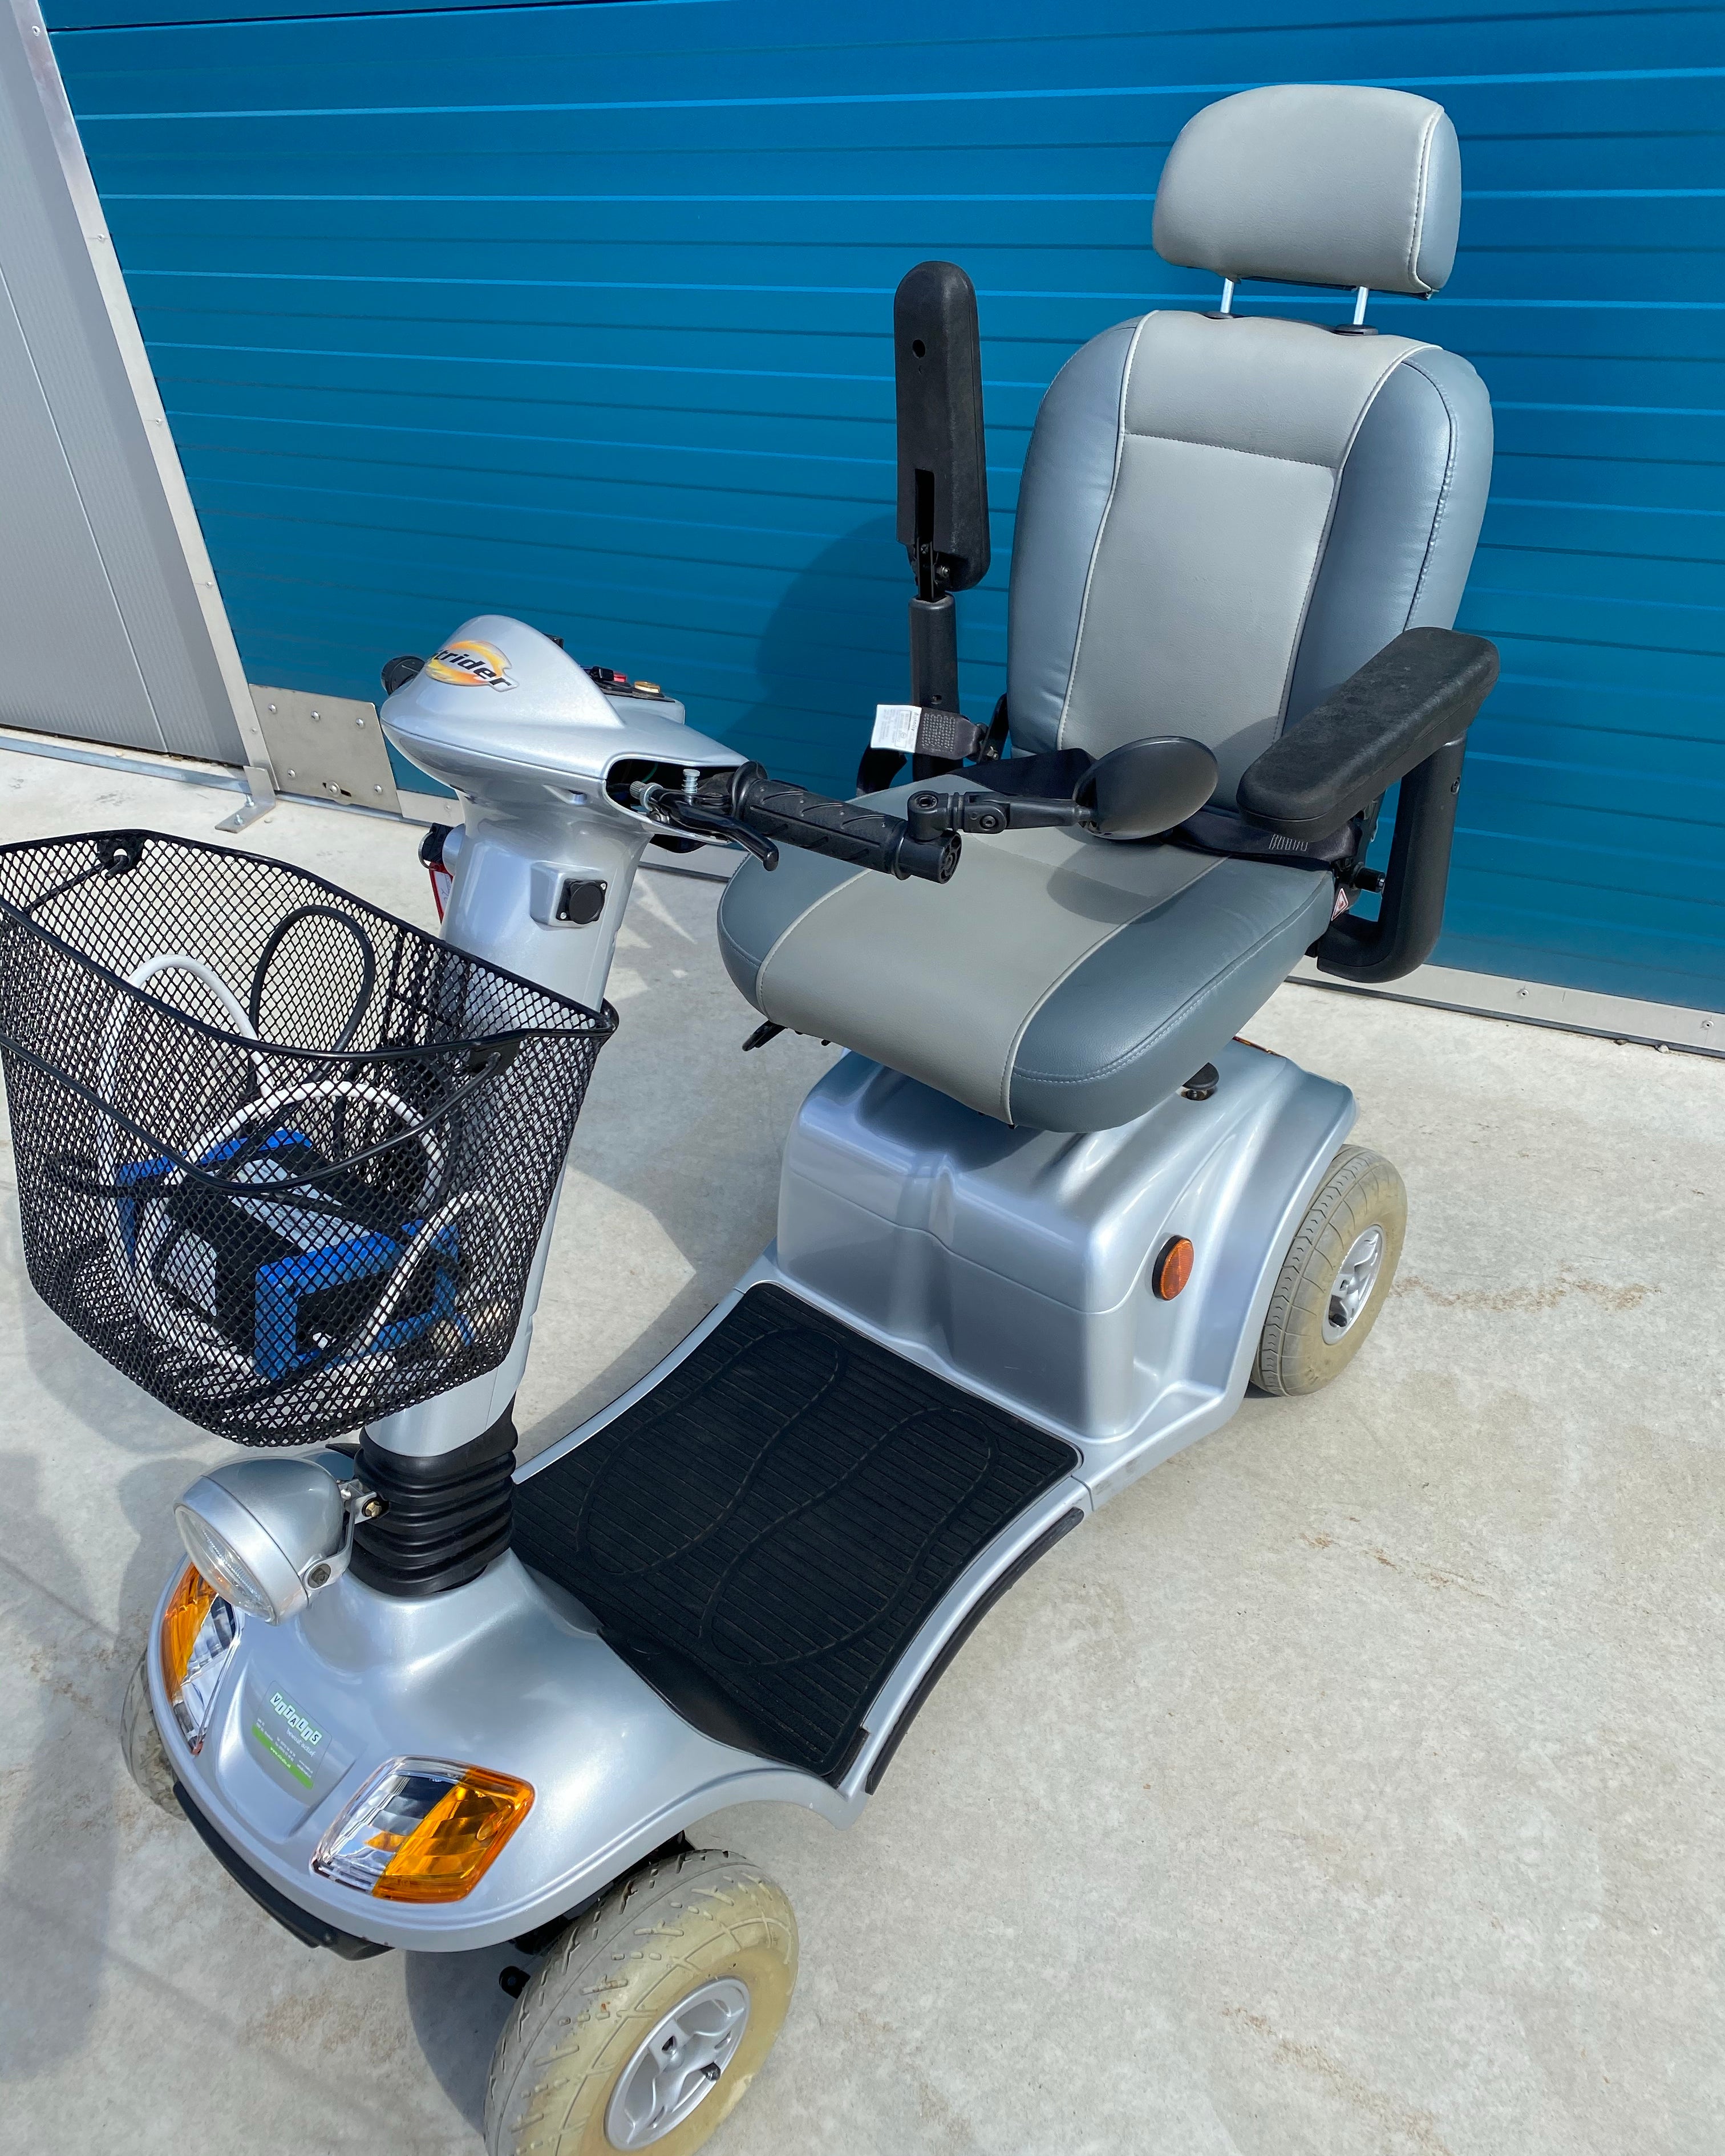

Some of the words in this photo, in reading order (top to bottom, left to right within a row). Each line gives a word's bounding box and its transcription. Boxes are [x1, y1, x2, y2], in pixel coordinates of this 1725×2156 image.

[430, 649, 512, 686] trider
[911, 711, 920, 732] Autoliv
[273, 1694, 320, 1742] VITALIS
